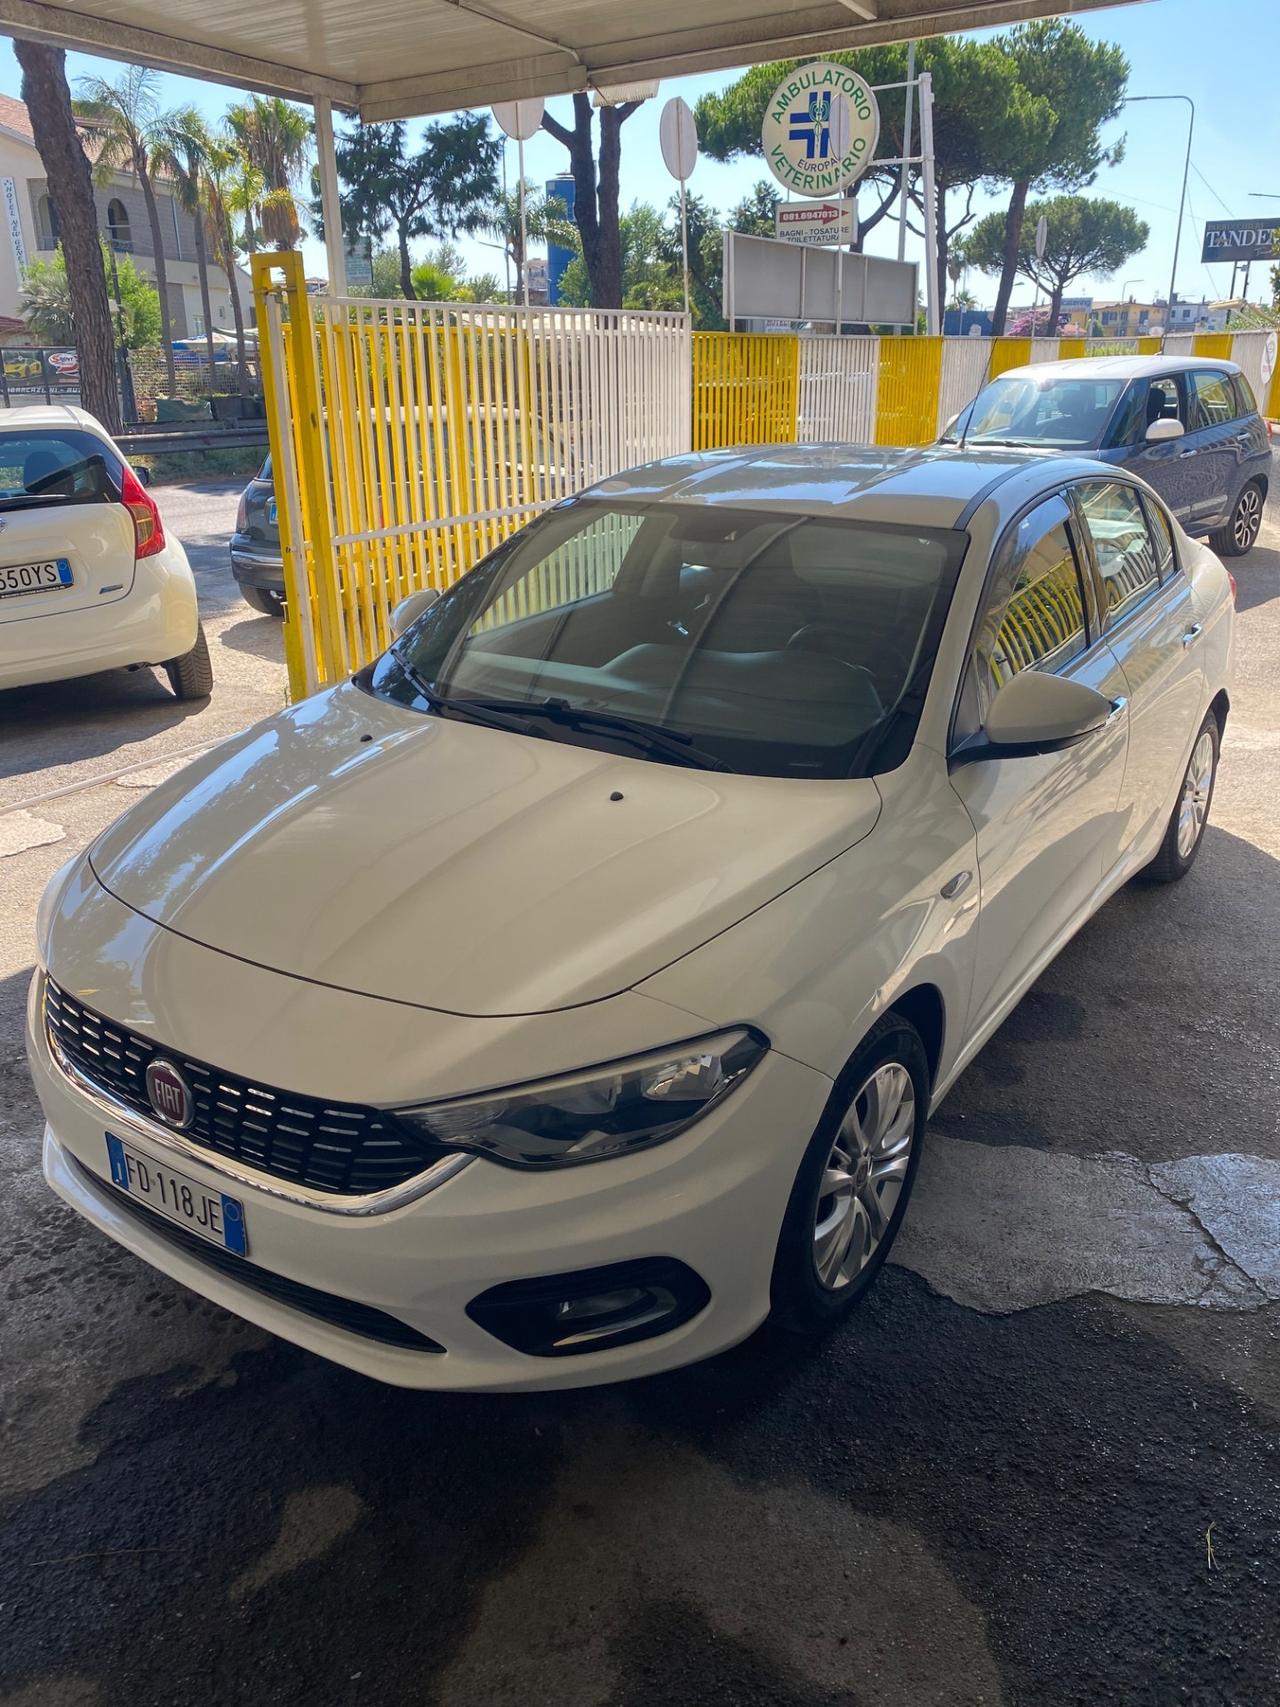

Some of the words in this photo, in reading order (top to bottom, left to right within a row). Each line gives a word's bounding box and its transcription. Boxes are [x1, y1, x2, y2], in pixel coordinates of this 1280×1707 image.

[771, 69, 872, 125] AMBULATORIO
[771, 137, 867, 190] VETERINARIO
[797, 158, 838, 173] EUROPA
[1206, 228, 1275, 248] TANDE
[154, 1079, 180, 1114] FIAT
